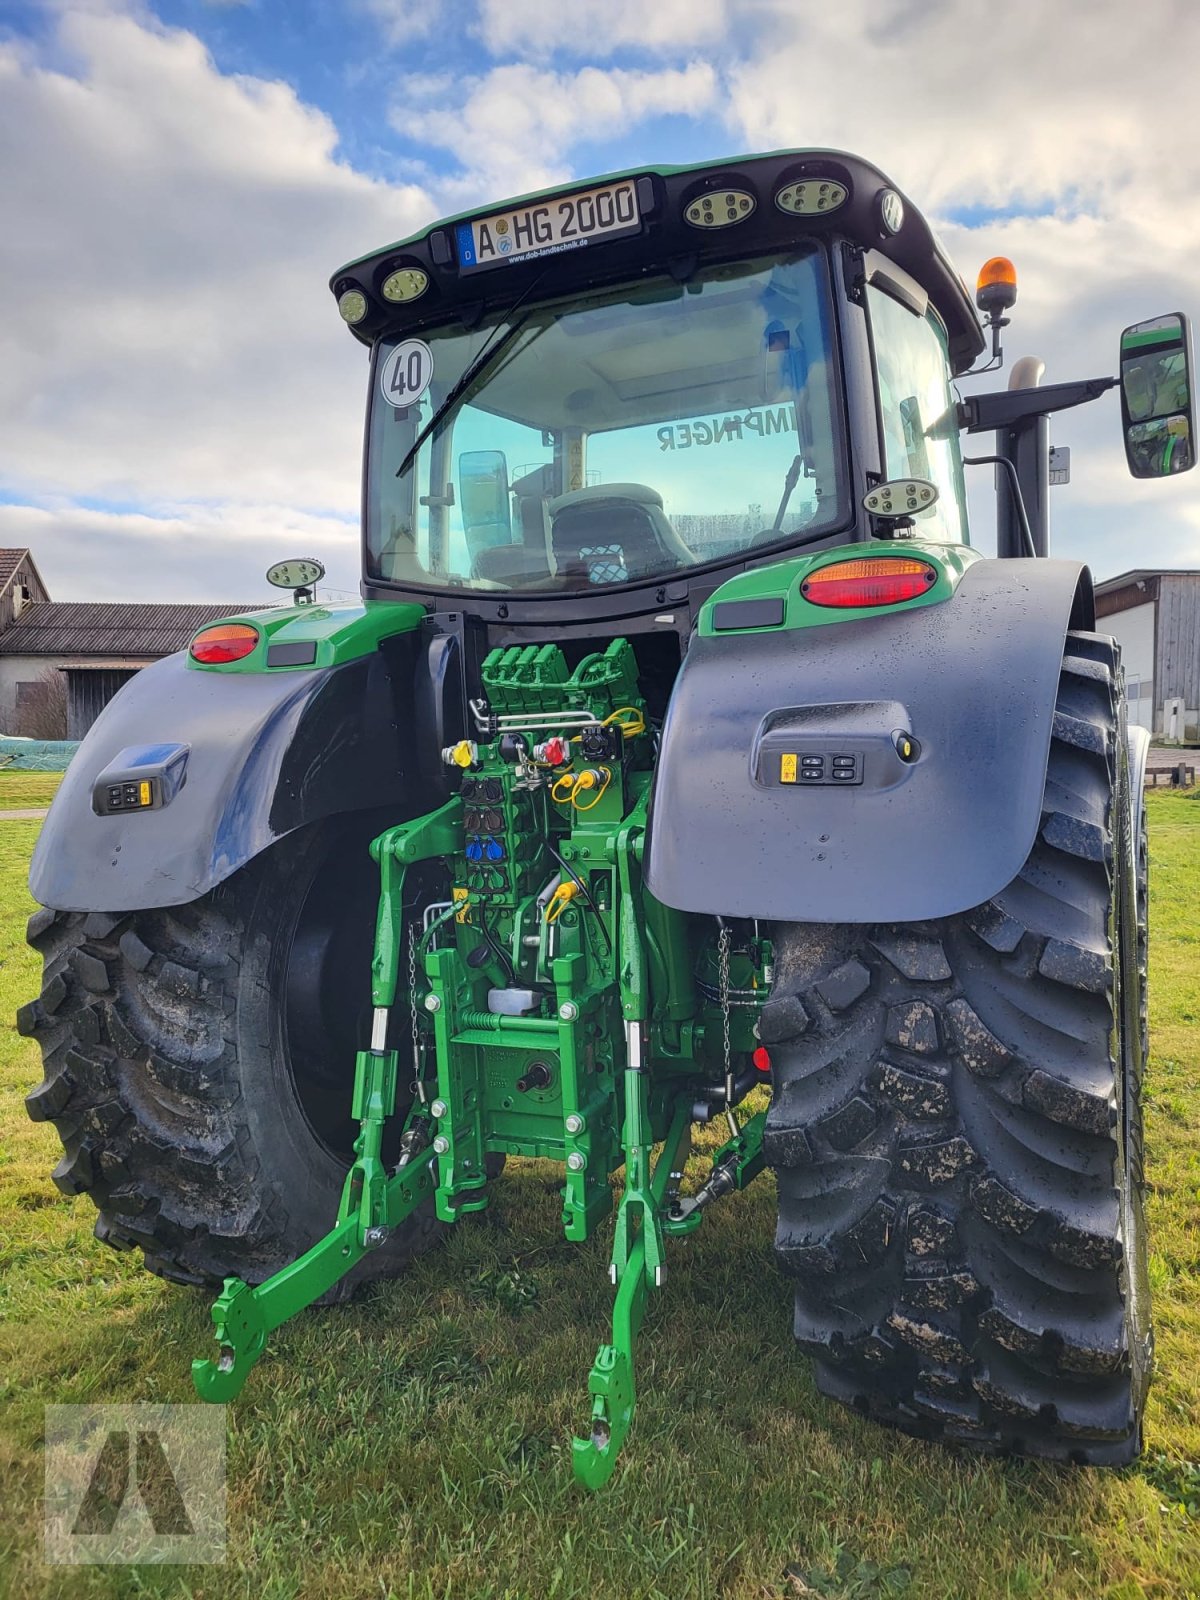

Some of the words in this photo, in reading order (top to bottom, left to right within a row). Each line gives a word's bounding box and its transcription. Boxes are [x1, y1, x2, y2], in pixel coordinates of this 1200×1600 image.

[479, 223, 495, 258] A
[512, 207, 553, 249] HG
[558, 186, 635, 238] 2000
[464, 250, 472, 260] D
[390, 350, 422, 396] 40
